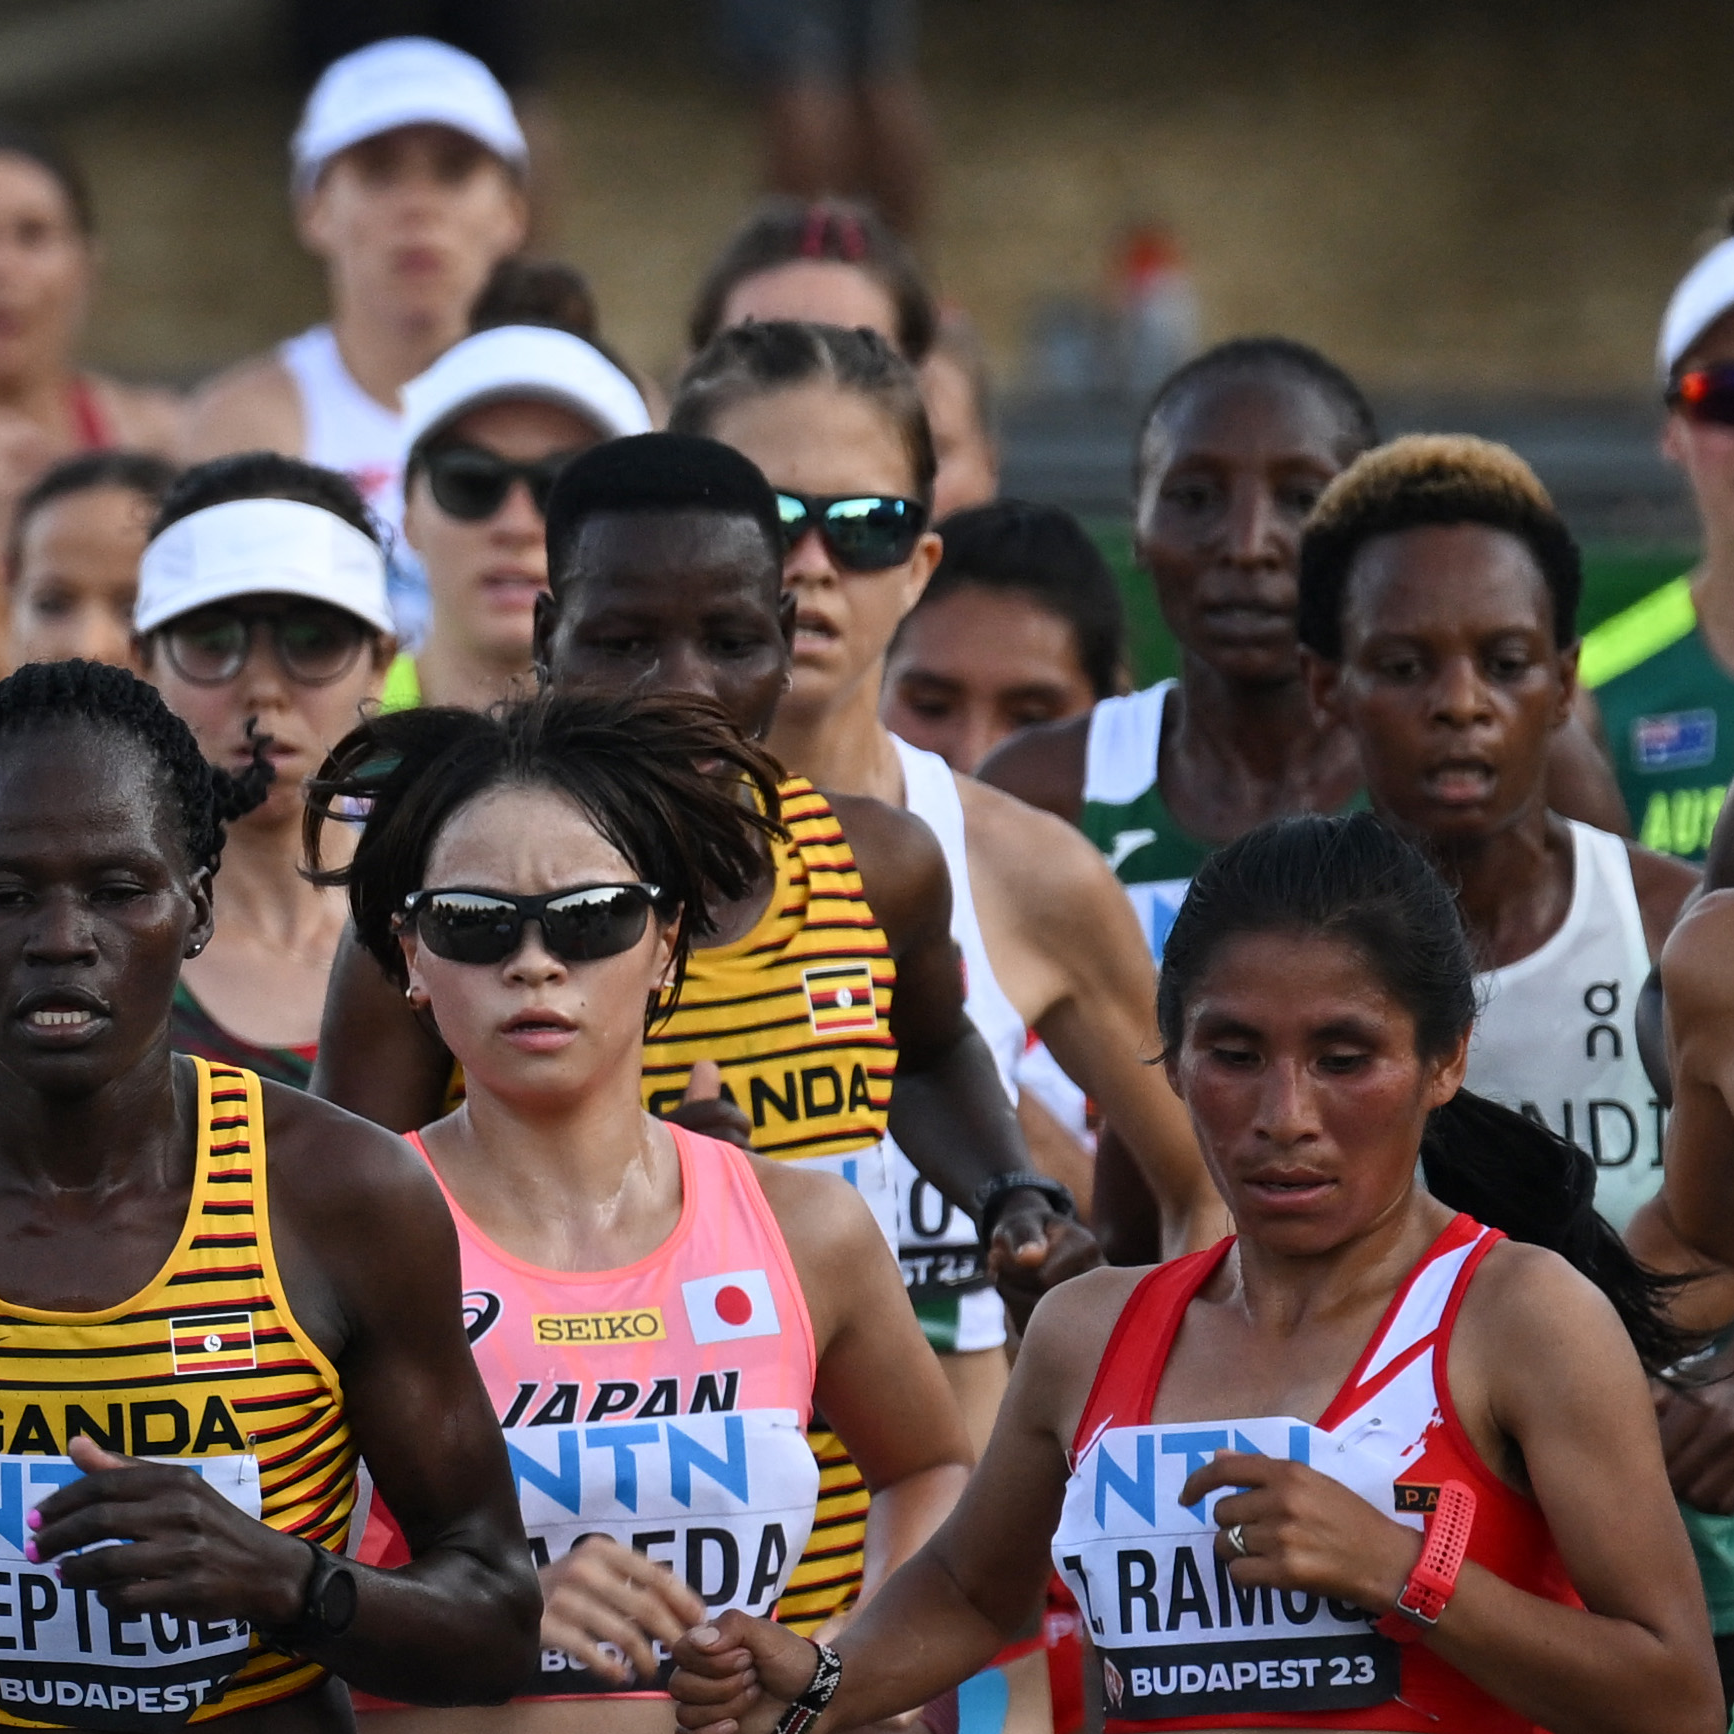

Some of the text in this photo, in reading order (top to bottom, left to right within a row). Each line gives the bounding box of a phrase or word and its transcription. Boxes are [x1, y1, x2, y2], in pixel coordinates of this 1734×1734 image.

[537, 1312, 659, 1342] SEIKO
[501, 1369, 740, 1428] JAPAN
[506, 1415, 749, 1517] NTN
[1131, 1655, 1376, 1697] BUDAPEST 23
